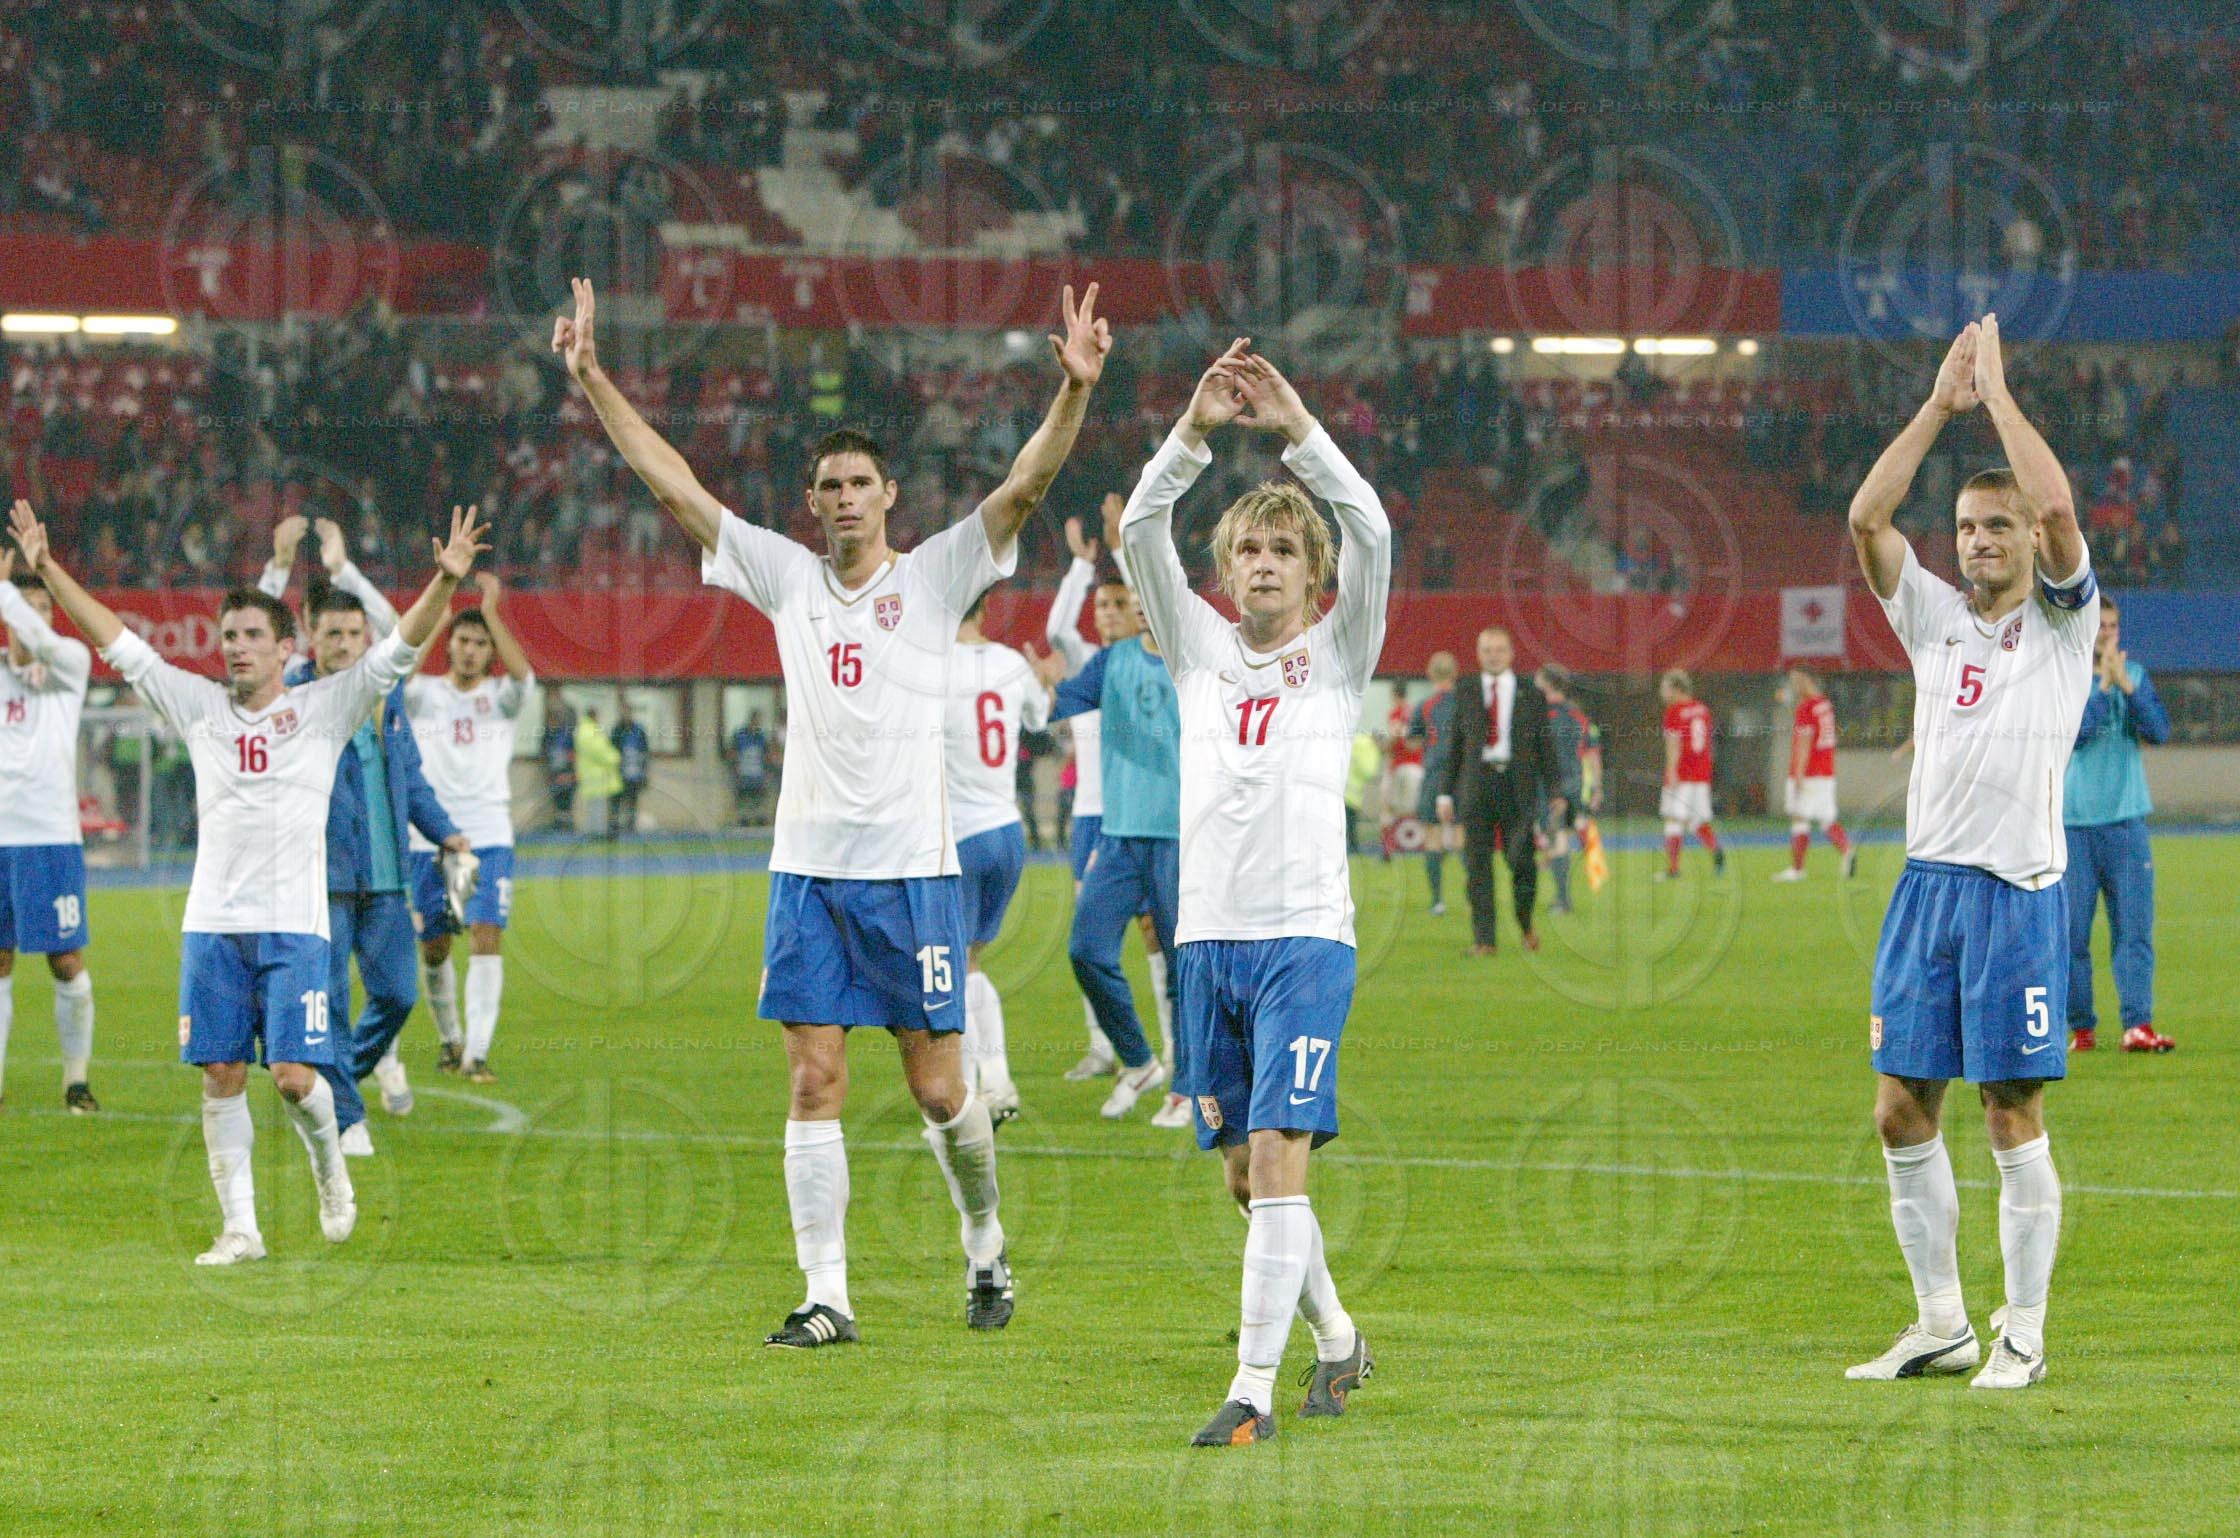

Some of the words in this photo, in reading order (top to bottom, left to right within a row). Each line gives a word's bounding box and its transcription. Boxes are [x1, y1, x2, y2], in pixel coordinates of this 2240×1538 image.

[827, 642, 862, 687] 15
[1956, 664, 1986, 707] 5
[453, 717, 475, 745] 13
[976, 691, 1006, 768] 6
[1236, 697, 1280, 746] 17
[235, 734, 267, 773] 16
[53, 895, 80, 928] 18
[916, 945, 952, 992] 15
[300, 990, 328, 1033] 16
[2025, 986, 2049, 1037] 5
[1289, 1035, 1331, 1091] 17
